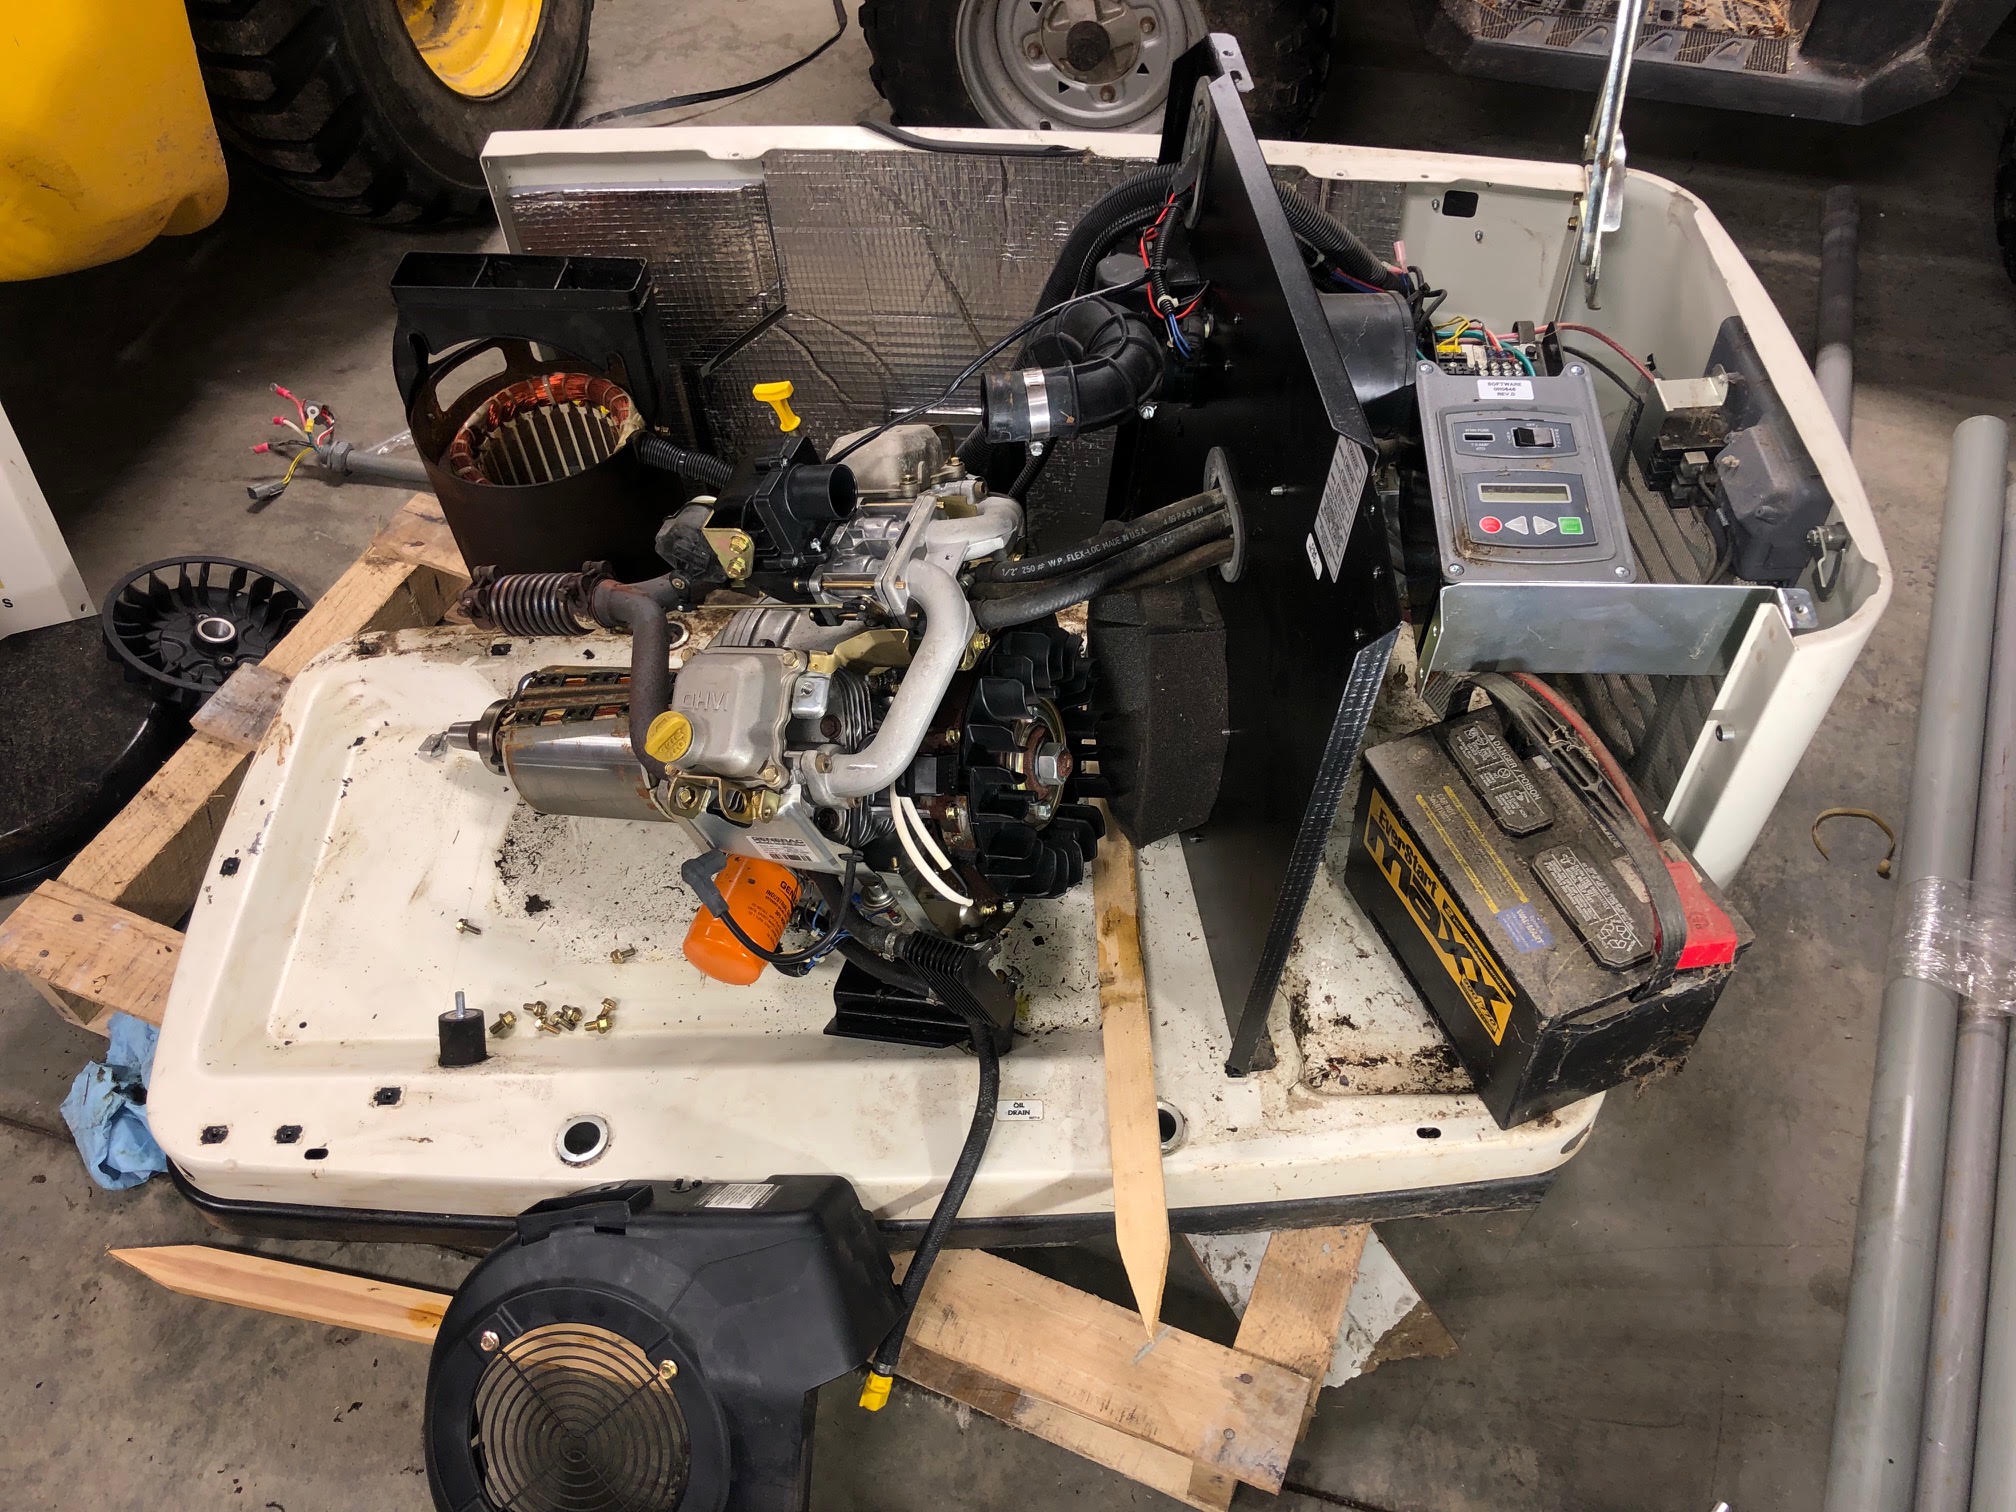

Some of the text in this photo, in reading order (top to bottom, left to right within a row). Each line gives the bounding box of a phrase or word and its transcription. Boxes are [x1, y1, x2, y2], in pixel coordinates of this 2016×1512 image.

[1022, 564, 1036, 574] 250
[1102, 536, 1122, 550] MADE
[1492, 739, 1517, 768] DANGER
[1516, 772, 1542, 801] POISON
[1379, 808, 1439, 900] EverStart
